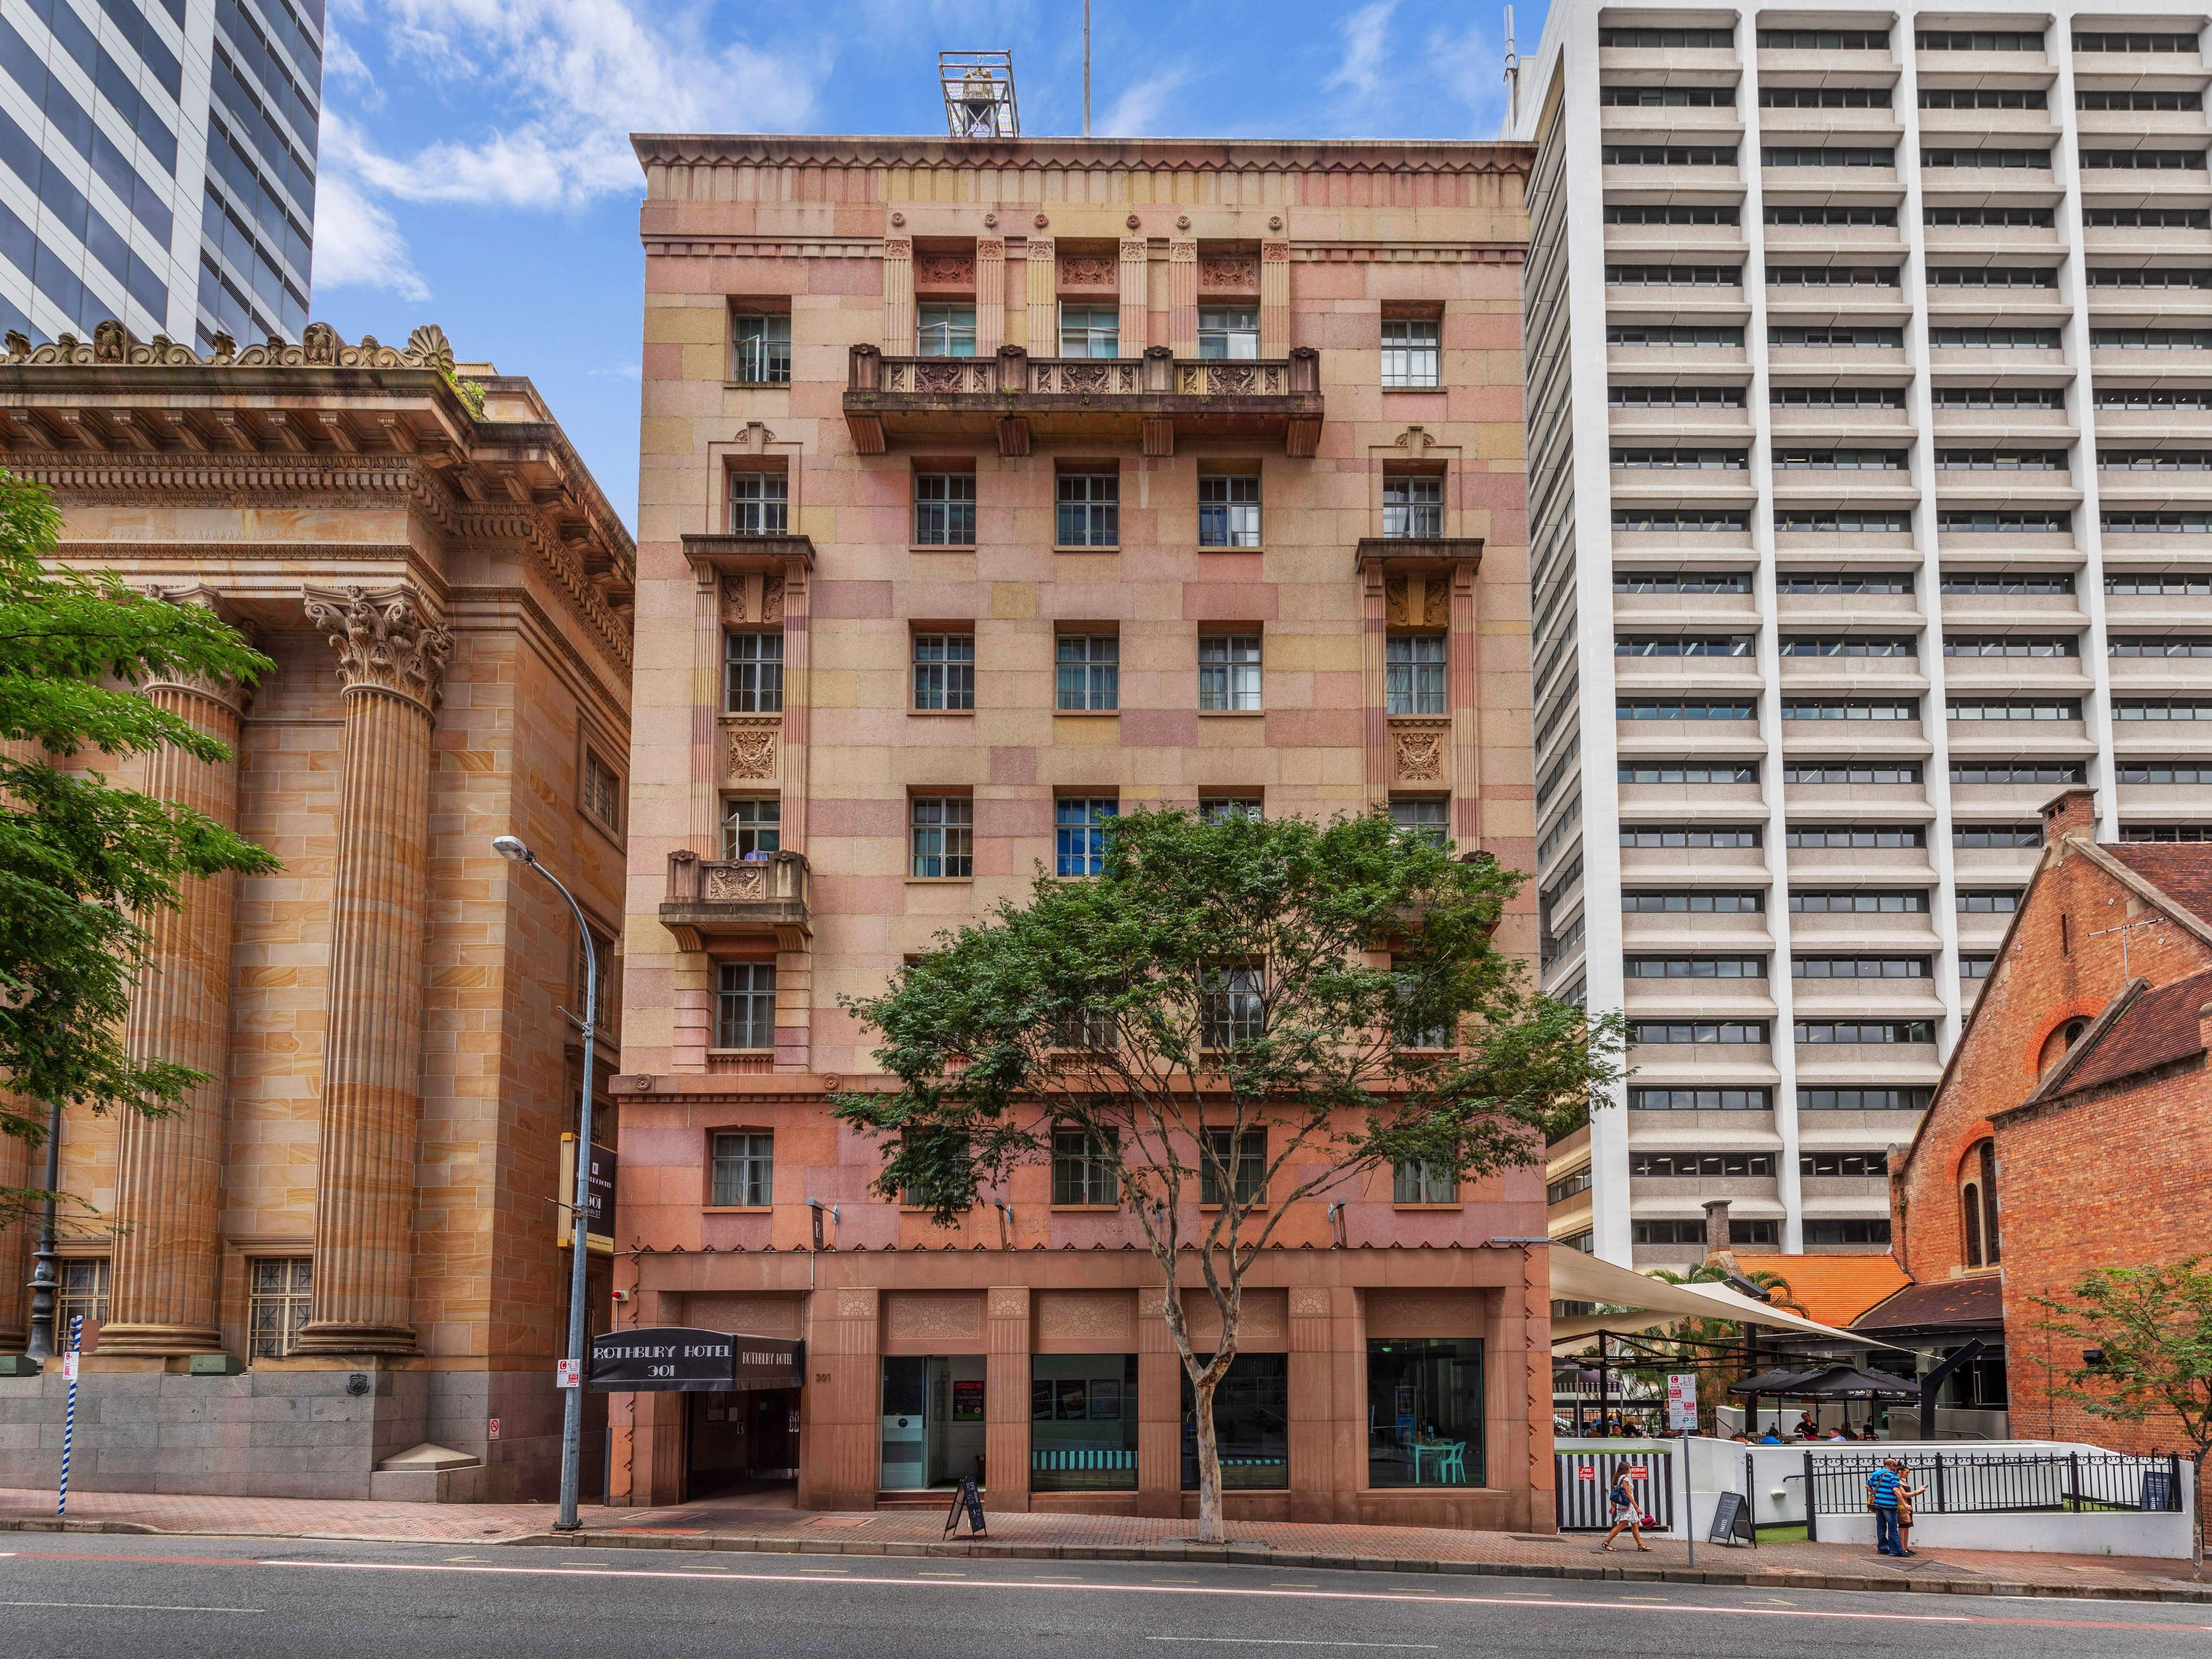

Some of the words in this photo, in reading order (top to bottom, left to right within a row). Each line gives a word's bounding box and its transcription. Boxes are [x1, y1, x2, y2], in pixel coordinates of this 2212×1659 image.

[815, 1221, 821, 1239] R
[593, 1346, 676, 1359] ROTHBURY
[684, 1345, 732, 1358] HOTEL
[743, 1351, 774, 1365] ROTHBURY
[777, 1353, 793, 1365] HOTEL
[647, 1365, 675, 1377] 301
[815, 1373, 831, 1382] 301
